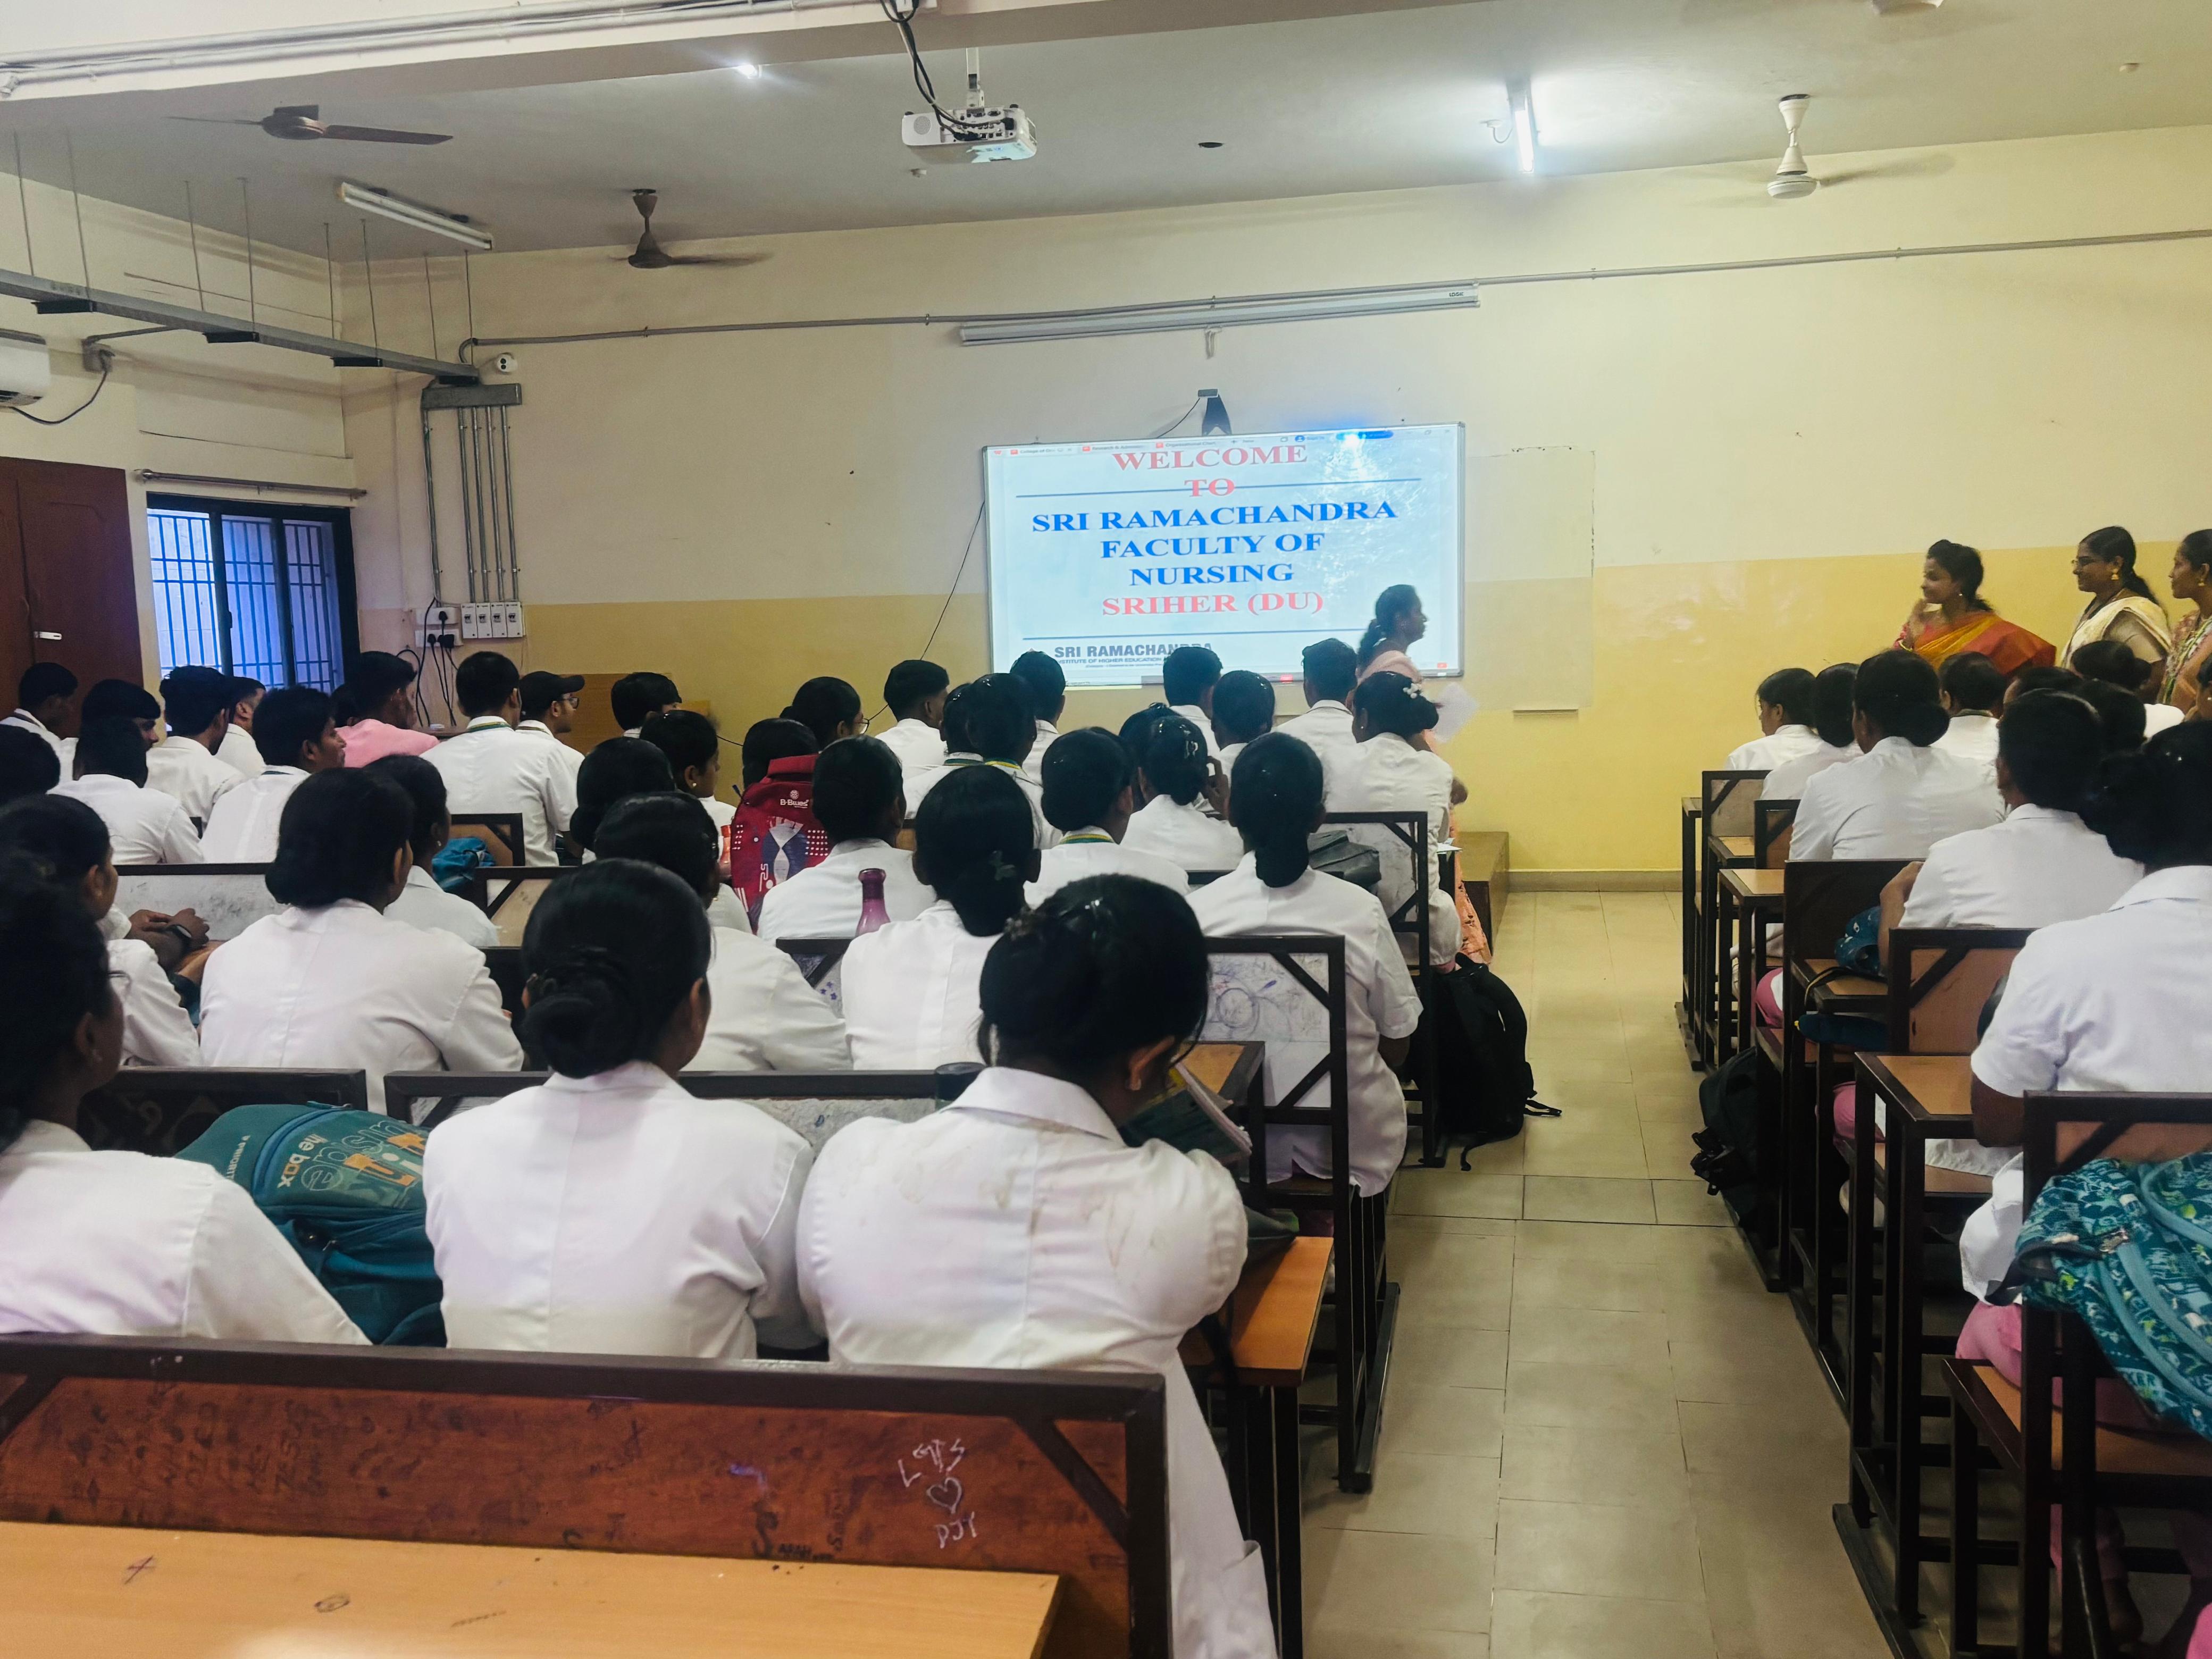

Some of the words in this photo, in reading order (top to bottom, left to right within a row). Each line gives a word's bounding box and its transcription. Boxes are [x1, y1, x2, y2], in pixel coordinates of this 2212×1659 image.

[1112, 445, 1307, 471] WELCOME
[1185, 477, 1235, 497] TO
[1032, 513, 1088, 532] SRI
[1100, 500, 1398, 530] RAMACHANDRA
[1101, 534, 1265, 559] FACULTY
[1275, 532, 1325, 552] OF
[1130, 563, 1294, 586] NURSING
[1102, 593, 1237, 616] SRIHER
[1249, 591, 1323, 615] (DU)
[1054, 647, 1080, 658] SRI
[1087, 643, 1212, 657] RAMACHANA
[225, 1142, 246, 1179] PRIORIT
[276, 1153, 311, 1188] box
